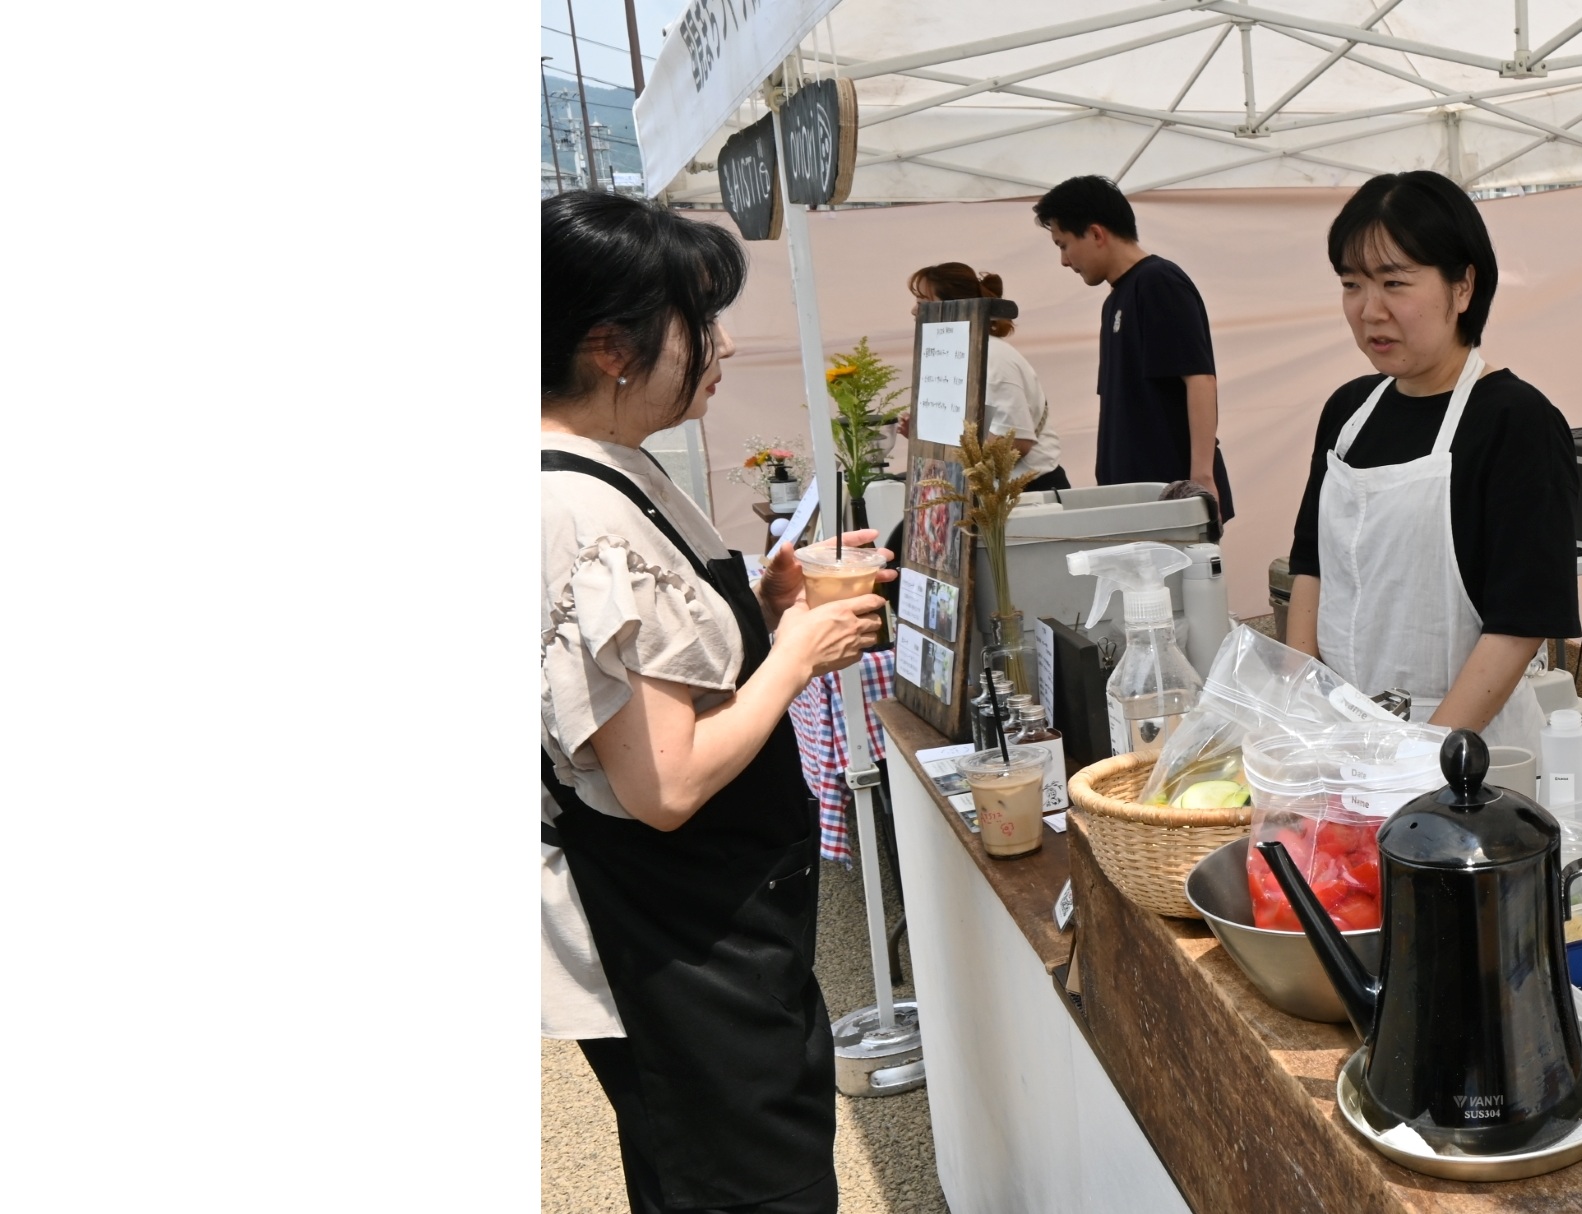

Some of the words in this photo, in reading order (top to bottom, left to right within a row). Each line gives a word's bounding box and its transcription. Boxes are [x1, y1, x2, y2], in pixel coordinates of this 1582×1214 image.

[1351, 768, 1367, 780] Date
[1351, 795, 1370, 809] Name
[1470, 1095, 1504, 1107] VANYI
[1464, 1109, 1501, 1119] SUS304
